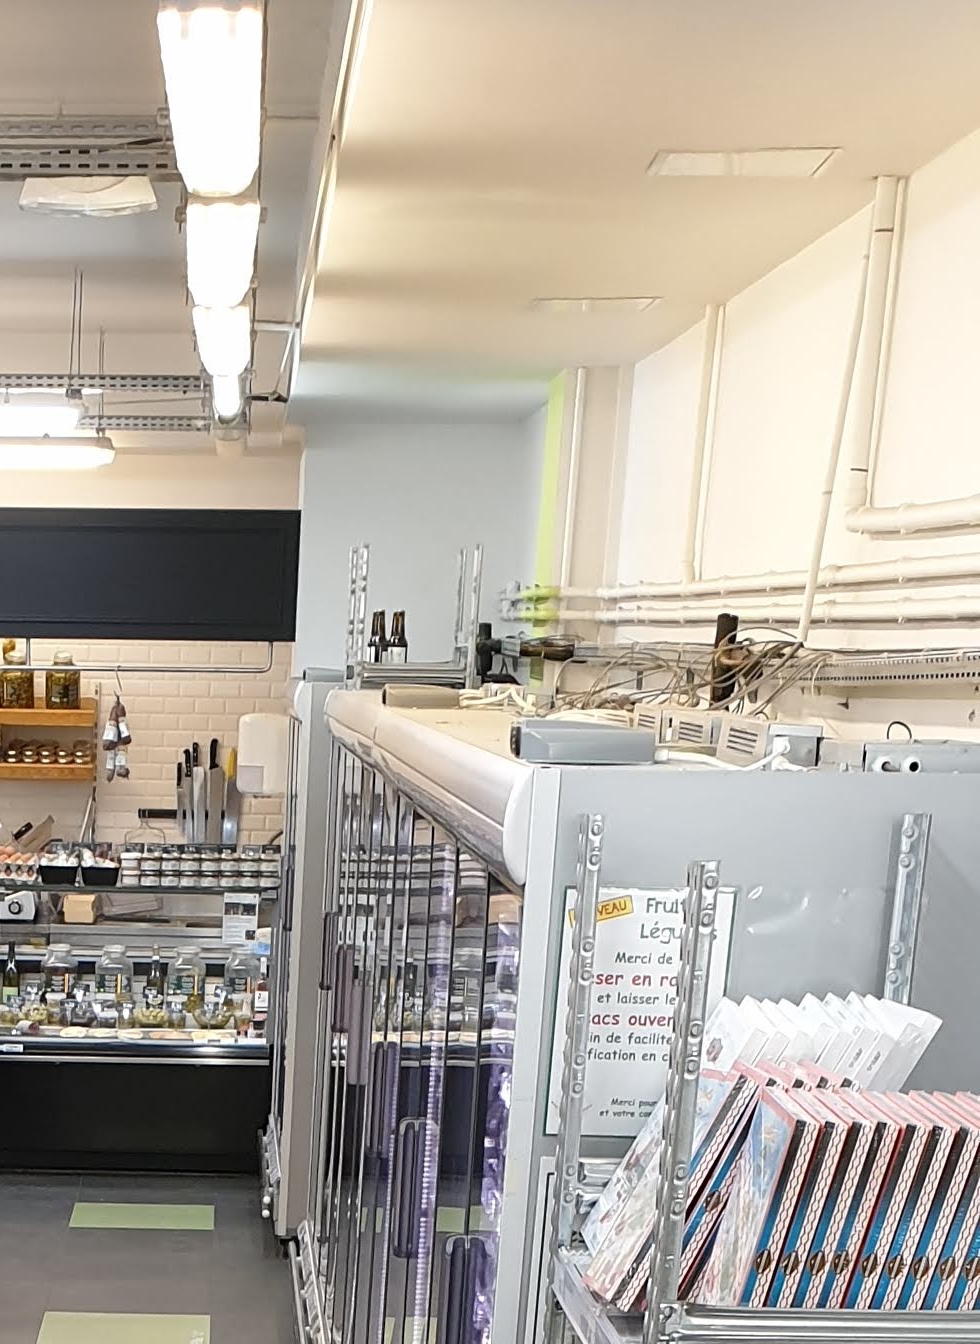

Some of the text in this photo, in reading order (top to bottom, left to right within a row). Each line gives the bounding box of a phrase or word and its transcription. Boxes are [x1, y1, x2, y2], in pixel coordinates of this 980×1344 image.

[597, 900, 627, 917] VEAU
[640, 921, 718, 944] Légus
[615, 952, 673, 965] Merci de
[593, 973, 624, 986] ser
[632, 974, 652, 987] en
[597, 993, 612, 1004] et
[617, 992, 660, 1006] laisser
[591, 1014, 675, 1028] acs ouver
[589, 1032, 600, 1044] in
[606, 1032, 622, 1044] de
[587, 1048, 636, 1061] fication
[641, 1052, 657, 1062] en
[611, 1097, 636, 1107] Merci
